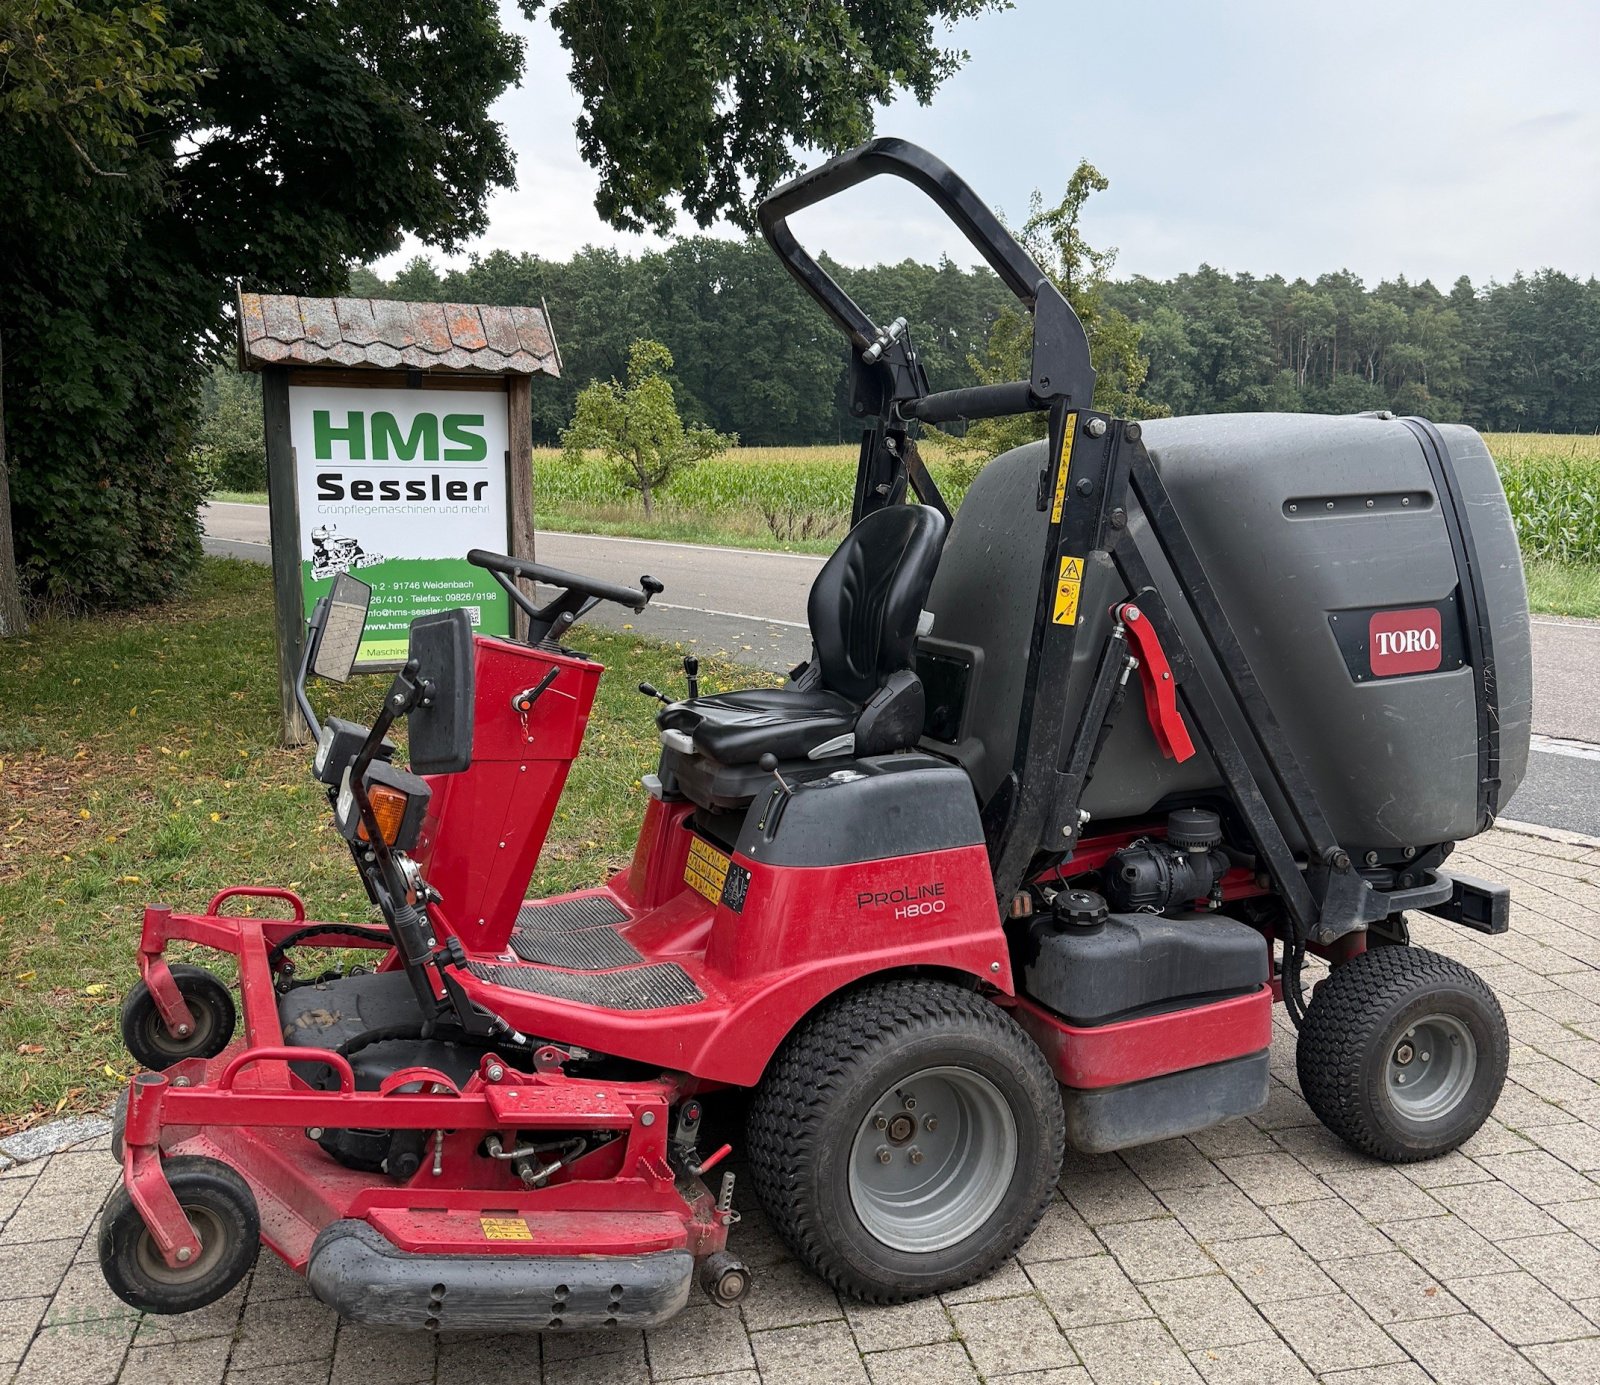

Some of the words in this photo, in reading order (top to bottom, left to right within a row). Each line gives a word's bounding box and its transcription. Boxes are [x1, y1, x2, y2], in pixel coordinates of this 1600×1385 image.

[312, 409, 488, 462] HMS
[316, 473, 489, 501] Sessler
[317, 503, 436, 516] Grünpflegemaschinen
[439, 504, 458, 515] und
[379, 582, 386, 591] 2
[393, 581, 420, 590] 91746
[422, 580, 474, 589] Weidenbach
[370, 595, 404, 605] 26/410
[410, 594, 443, 603] Telefax:
[445, 592, 497, 602] 09826/9198
[1375, 627, 1437, 656] TORO
[894, 899, 946, 920] H800
